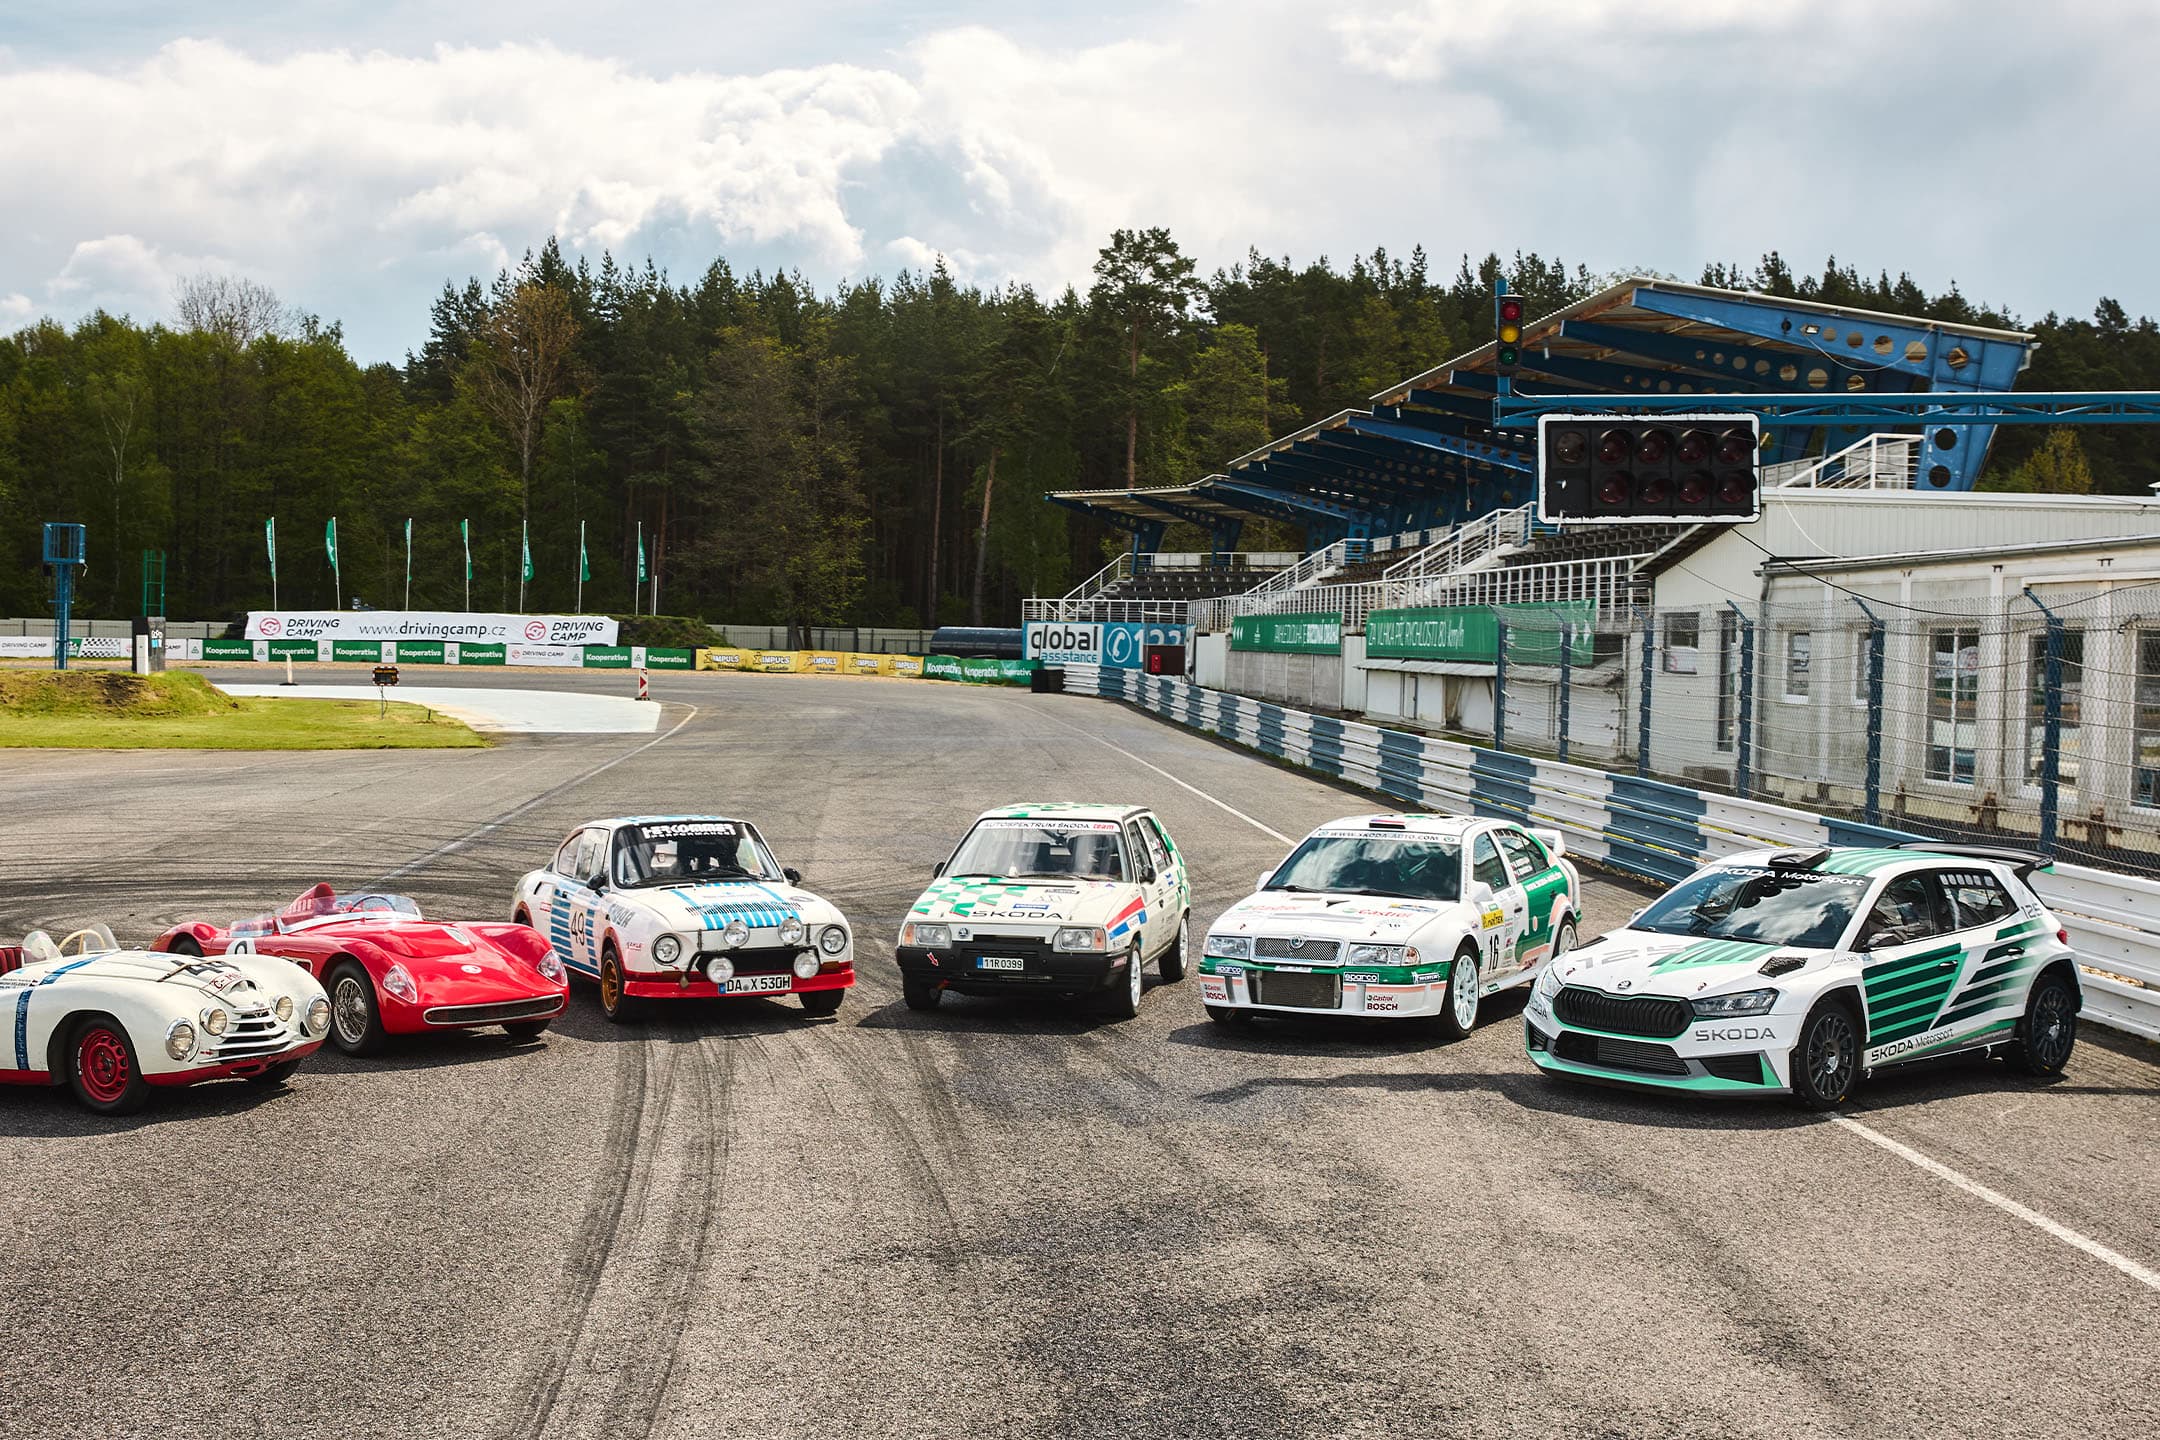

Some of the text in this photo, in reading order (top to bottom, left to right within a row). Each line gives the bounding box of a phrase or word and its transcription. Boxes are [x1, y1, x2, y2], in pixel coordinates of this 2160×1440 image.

[286, 618, 341, 628] DRIVING
[552, 621, 604, 632] DRIVING
[285, 628, 323, 637] CAMP
[359, 620, 506, 638] www.drivingcamp.cz
[550, 632, 587, 641] CAMP
[1031, 624, 1098, 659] global
[205, 646, 249, 656] Kooperativa
[271, 647, 315, 657] Kooperativa
[335, 647, 378, 657] Kooperativa
[400, 647, 442, 658] Kooperativa
[461, 650, 503, 660] Kooperativa
[586, 653, 628, 663] Kooperativa
[648, 654, 687, 665] Kooperativa
[711, 654, 740, 664] IMPULS
[761, 655, 790, 665] IMPULS
[1041, 651, 1097, 663] assistance
[926, 662, 962, 675] Kooperativa
[1781, 871, 1865, 887] Motorsport
[2021, 902, 2043, 919] 125
[571, 910, 585, 946] 49
[1488, 933, 1500, 974] 16
[1344, 973, 1378, 982] sparco
[727, 975, 791, 992] DA X 530H
[1205, 991, 1227, 1001] BOSCH
[1367, 1002, 1398, 1011] BOSCH
[1914, 1028, 1954, 1048] Motorsport
